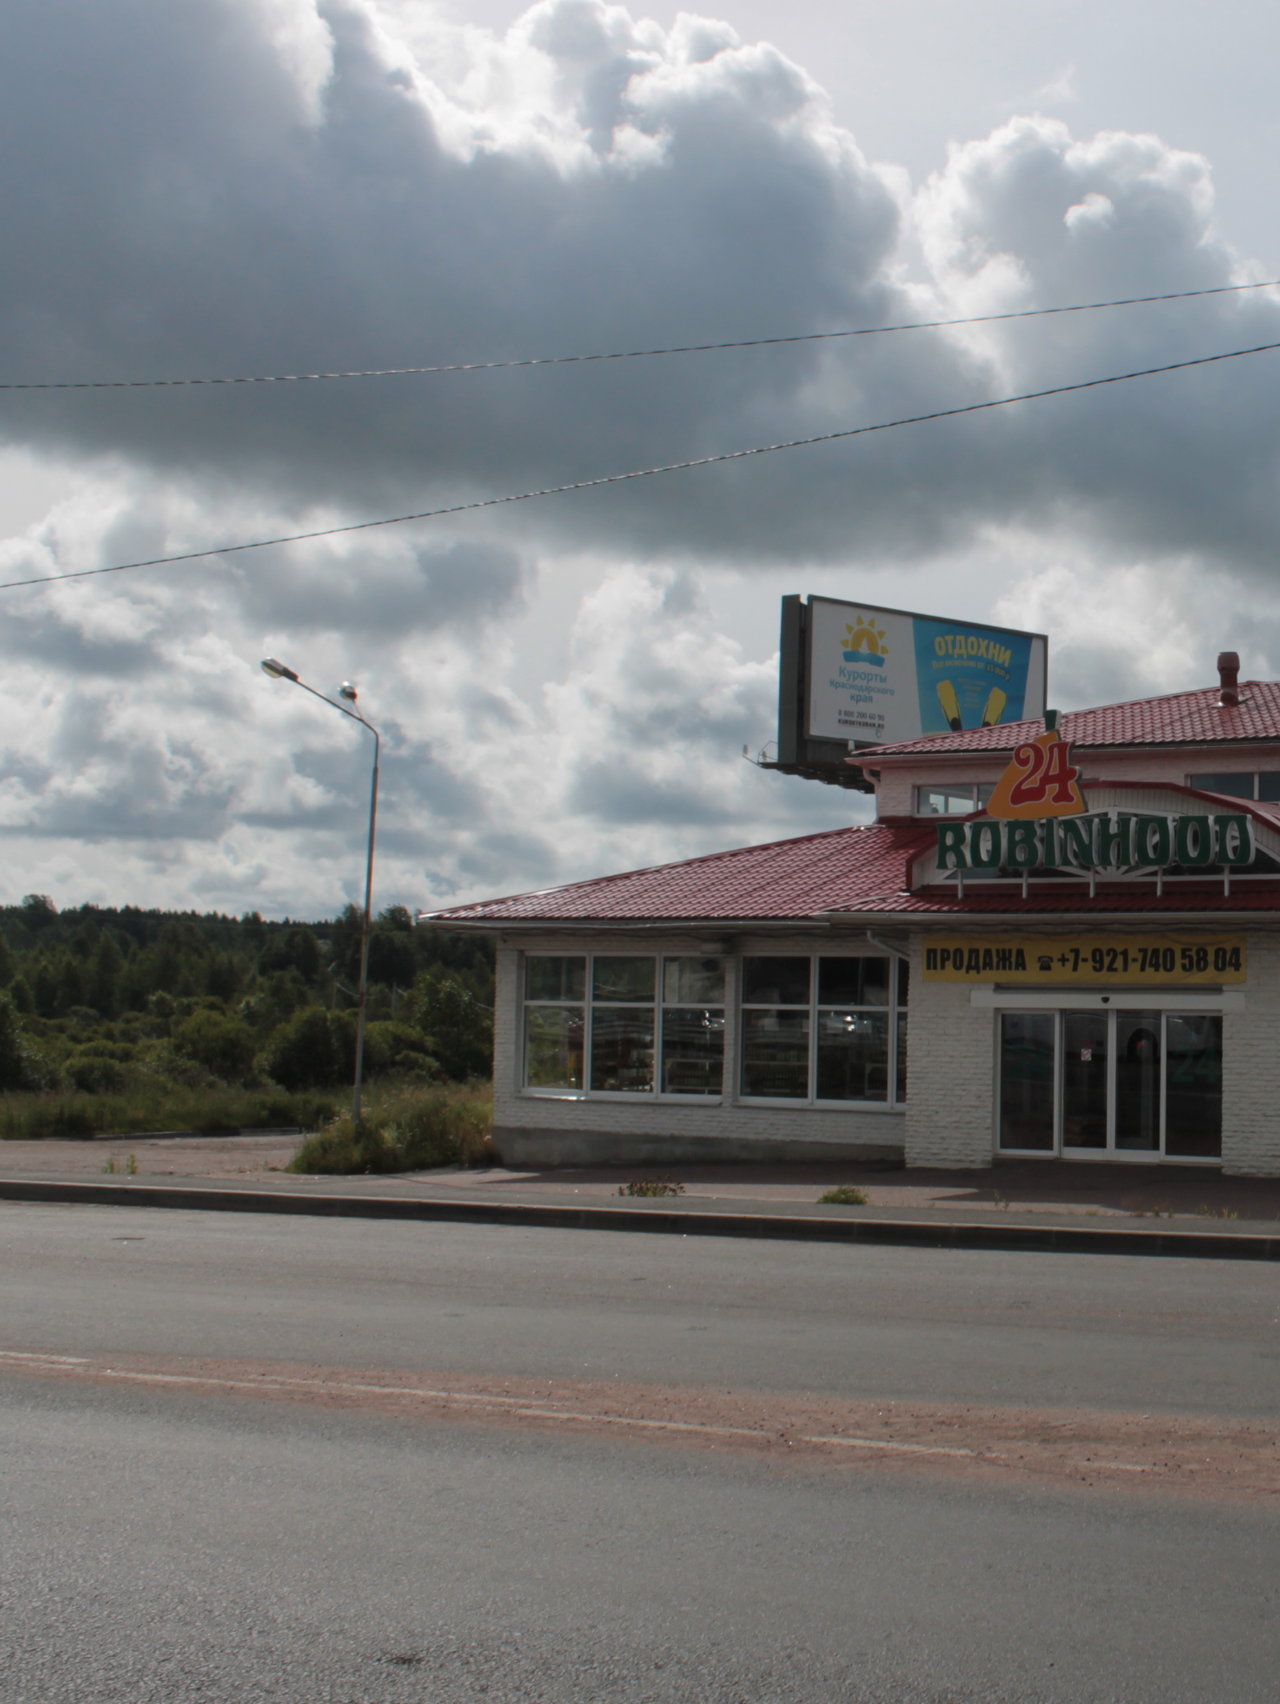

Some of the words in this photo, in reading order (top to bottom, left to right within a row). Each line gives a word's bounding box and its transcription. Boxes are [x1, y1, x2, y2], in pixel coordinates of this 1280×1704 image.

[935, 635, 1012, 667] ОТДОХНИ
[829, 679, 896, 696] Краснодарского
[838, 665, 887, 684] Курорты
[850, 693, 873, 705] края
[1010, 742, 1078, 807] 24
[936, 813, 1255, 870] ROBINHOOD
[926, 947, 1027, 974] ПРОДАЖА
[1181, 947, 1209, 972] 58
[1213, 947, 1242, 972] 04
